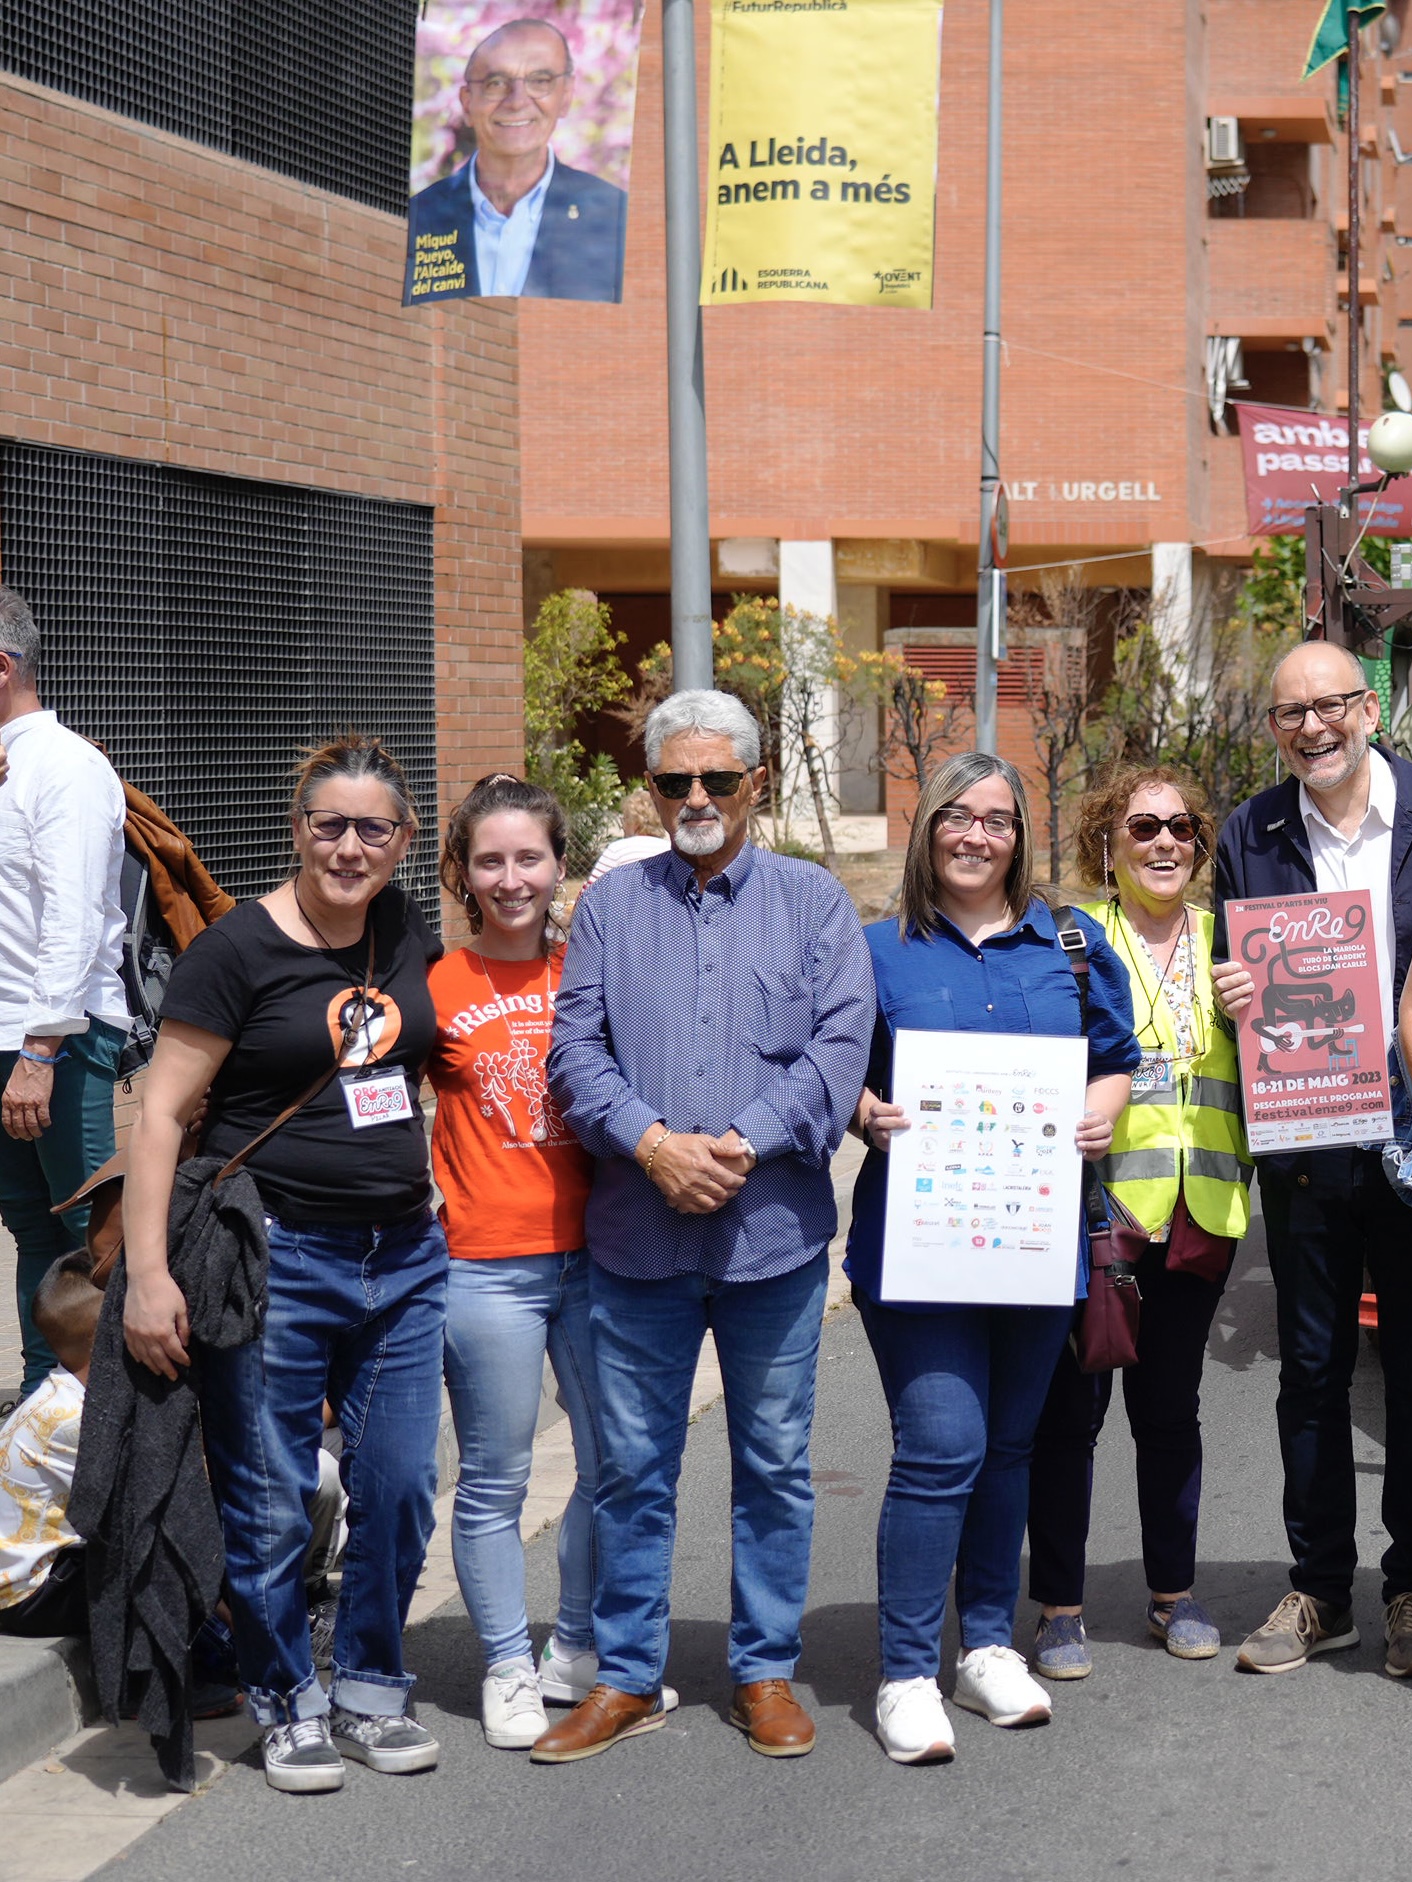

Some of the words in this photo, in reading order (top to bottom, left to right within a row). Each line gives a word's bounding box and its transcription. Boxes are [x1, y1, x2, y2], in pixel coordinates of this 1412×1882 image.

[719, 142, 740, 170] A
[749, 136, 858, 171] Lleida,
[718, 179, 800, 205] anem
[810, 179, 830, 201] a
[841, 174, 911, 204] més
[415, 229, 458, 249] Miquel
[415, 248, 456, 265] Pueyo,
[413, 259, 465, 280] l'Alcalde
[758, 269, 811, 278] ESQUERRA
[412, 279, 432, 296] del
[433, 273, 466, 292] canvi
[757, 280, 829, 290] REPUBLICANA
[1062, 481, 1162, 501] URGELL
[1245, 903, 1276, 911] FESTIVAL
[1277, 900, 1302, 908] D'ARTS
[1302, 956, 1322, 964] TURÓ
[1333, 952, 1366, 961] GARDENY
[1333, 944, 1366, 953] MARIOLA
[452, 993, 544, 1036] Rising
[1251, 1080, 1283, 1094] 18-21
[1286, 1079, 1305, 1091] DE
[1308, 1074, 1348, 1090] MAIG
[1352, 1071, 1382, 1084] 2023
[1253, 1097, 1318, 1110] DESCARREGA'T
[1330, 1090, 1383, 1102] PROGRAMA
[1254, 1101, 1384, 1120] festivalenre9.com
[501, 1141, 518, 1150] Also
